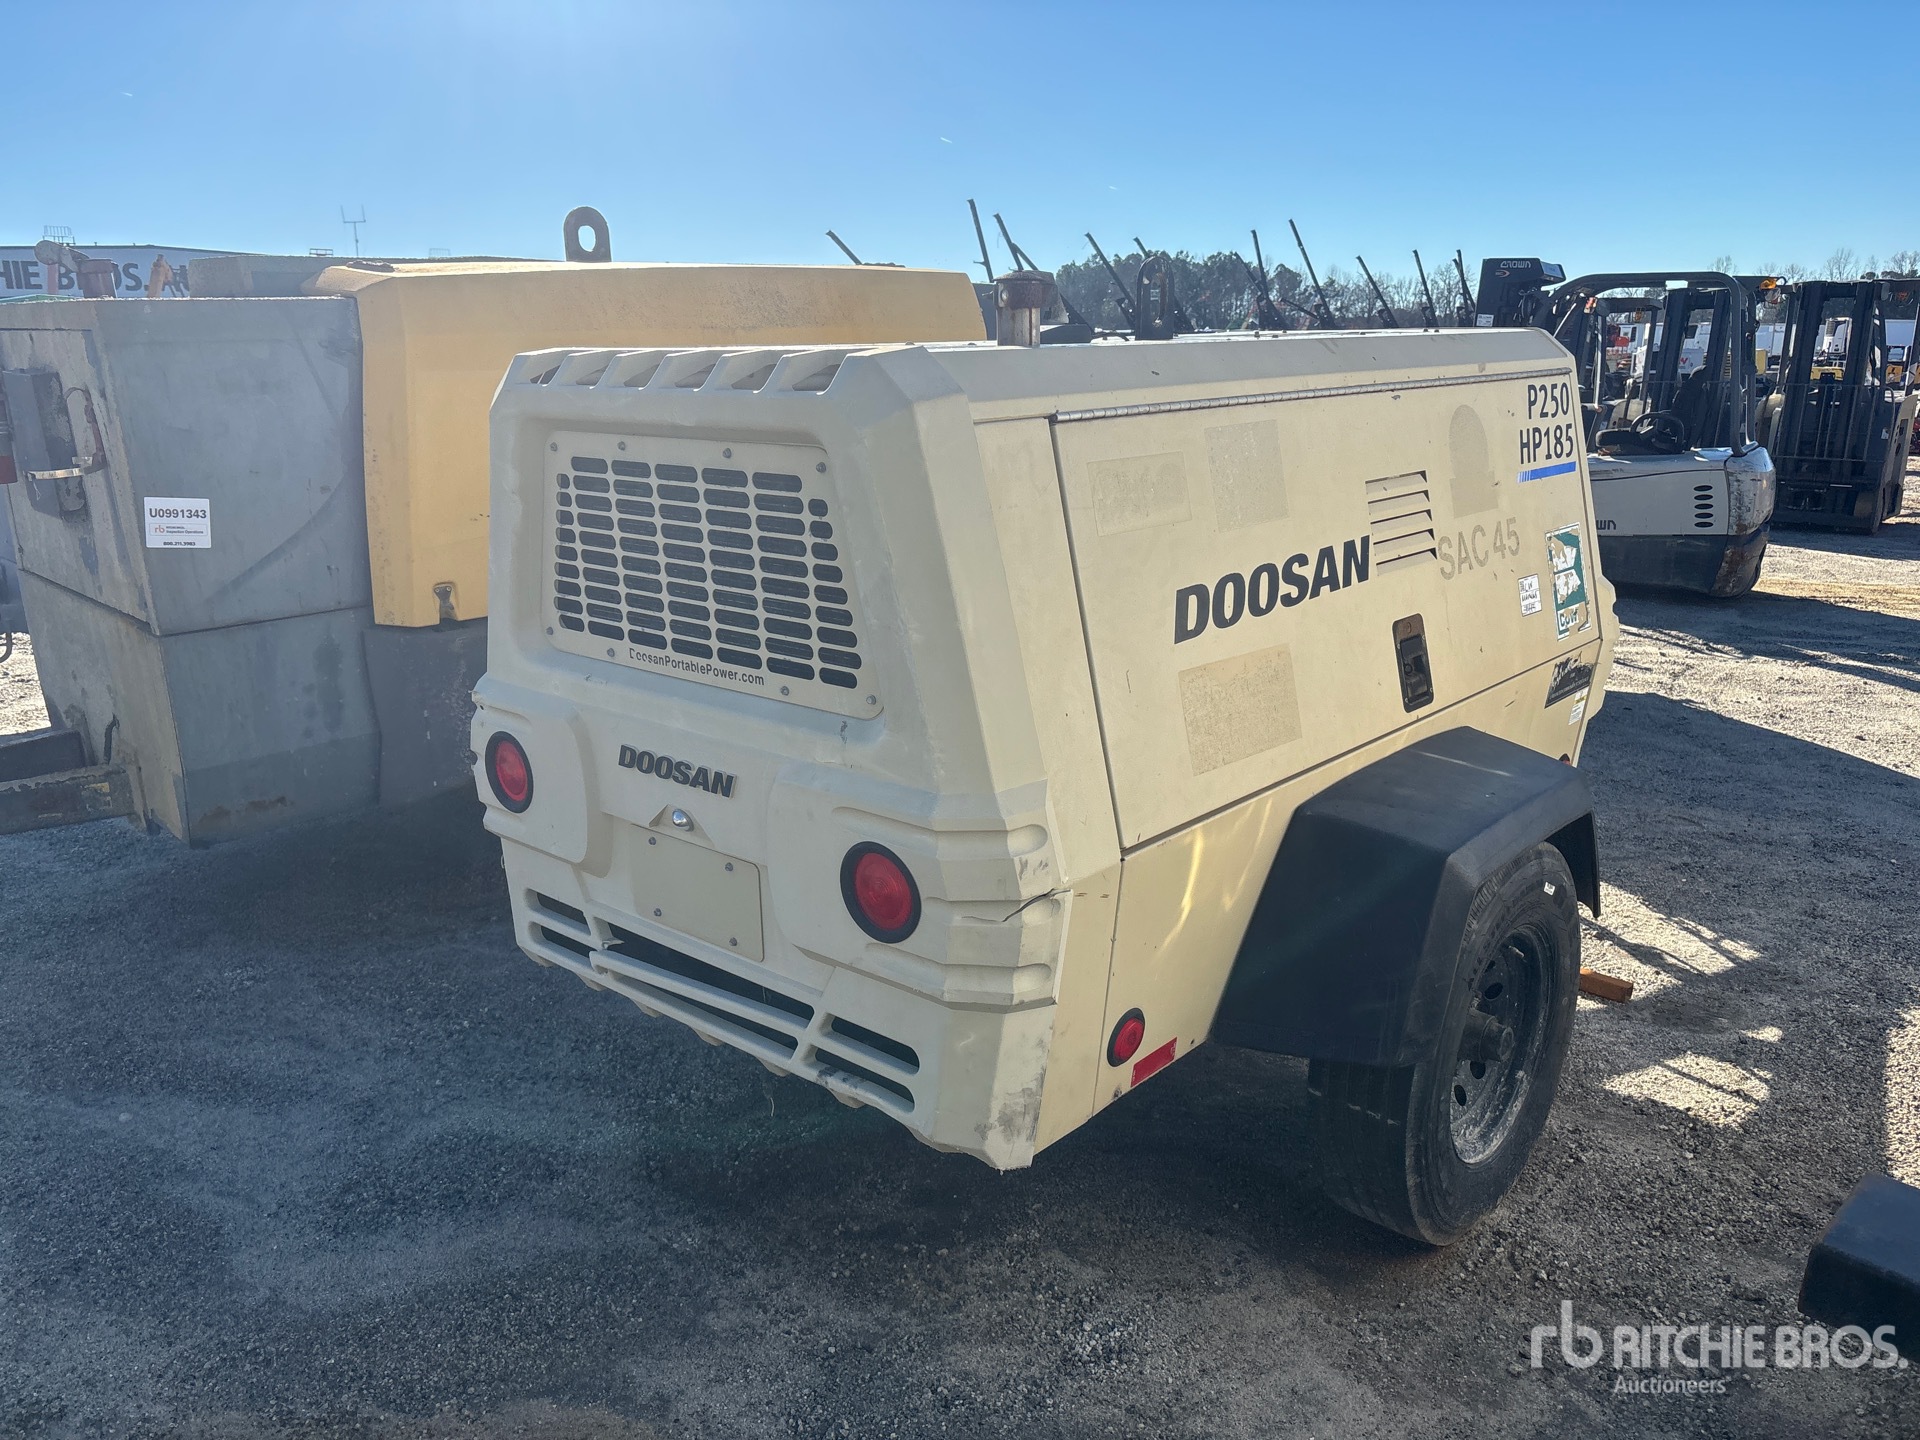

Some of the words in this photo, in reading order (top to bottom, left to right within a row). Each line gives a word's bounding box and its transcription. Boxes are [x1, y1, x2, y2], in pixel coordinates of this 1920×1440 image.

[1500, 260, 1531, 268] CROWN
[1527, 382, 1569, 419] P250
[1519, 423, 1573, 464] HP185
[149, 508, 207, 519] U0991343
[1438, 524, 1489, 580] SAC
[1493, 517, 1520, 559] 45
[1174, 535, 1370, 644] DOOSAN
[618, 744, 736, 798] DOOSAN
